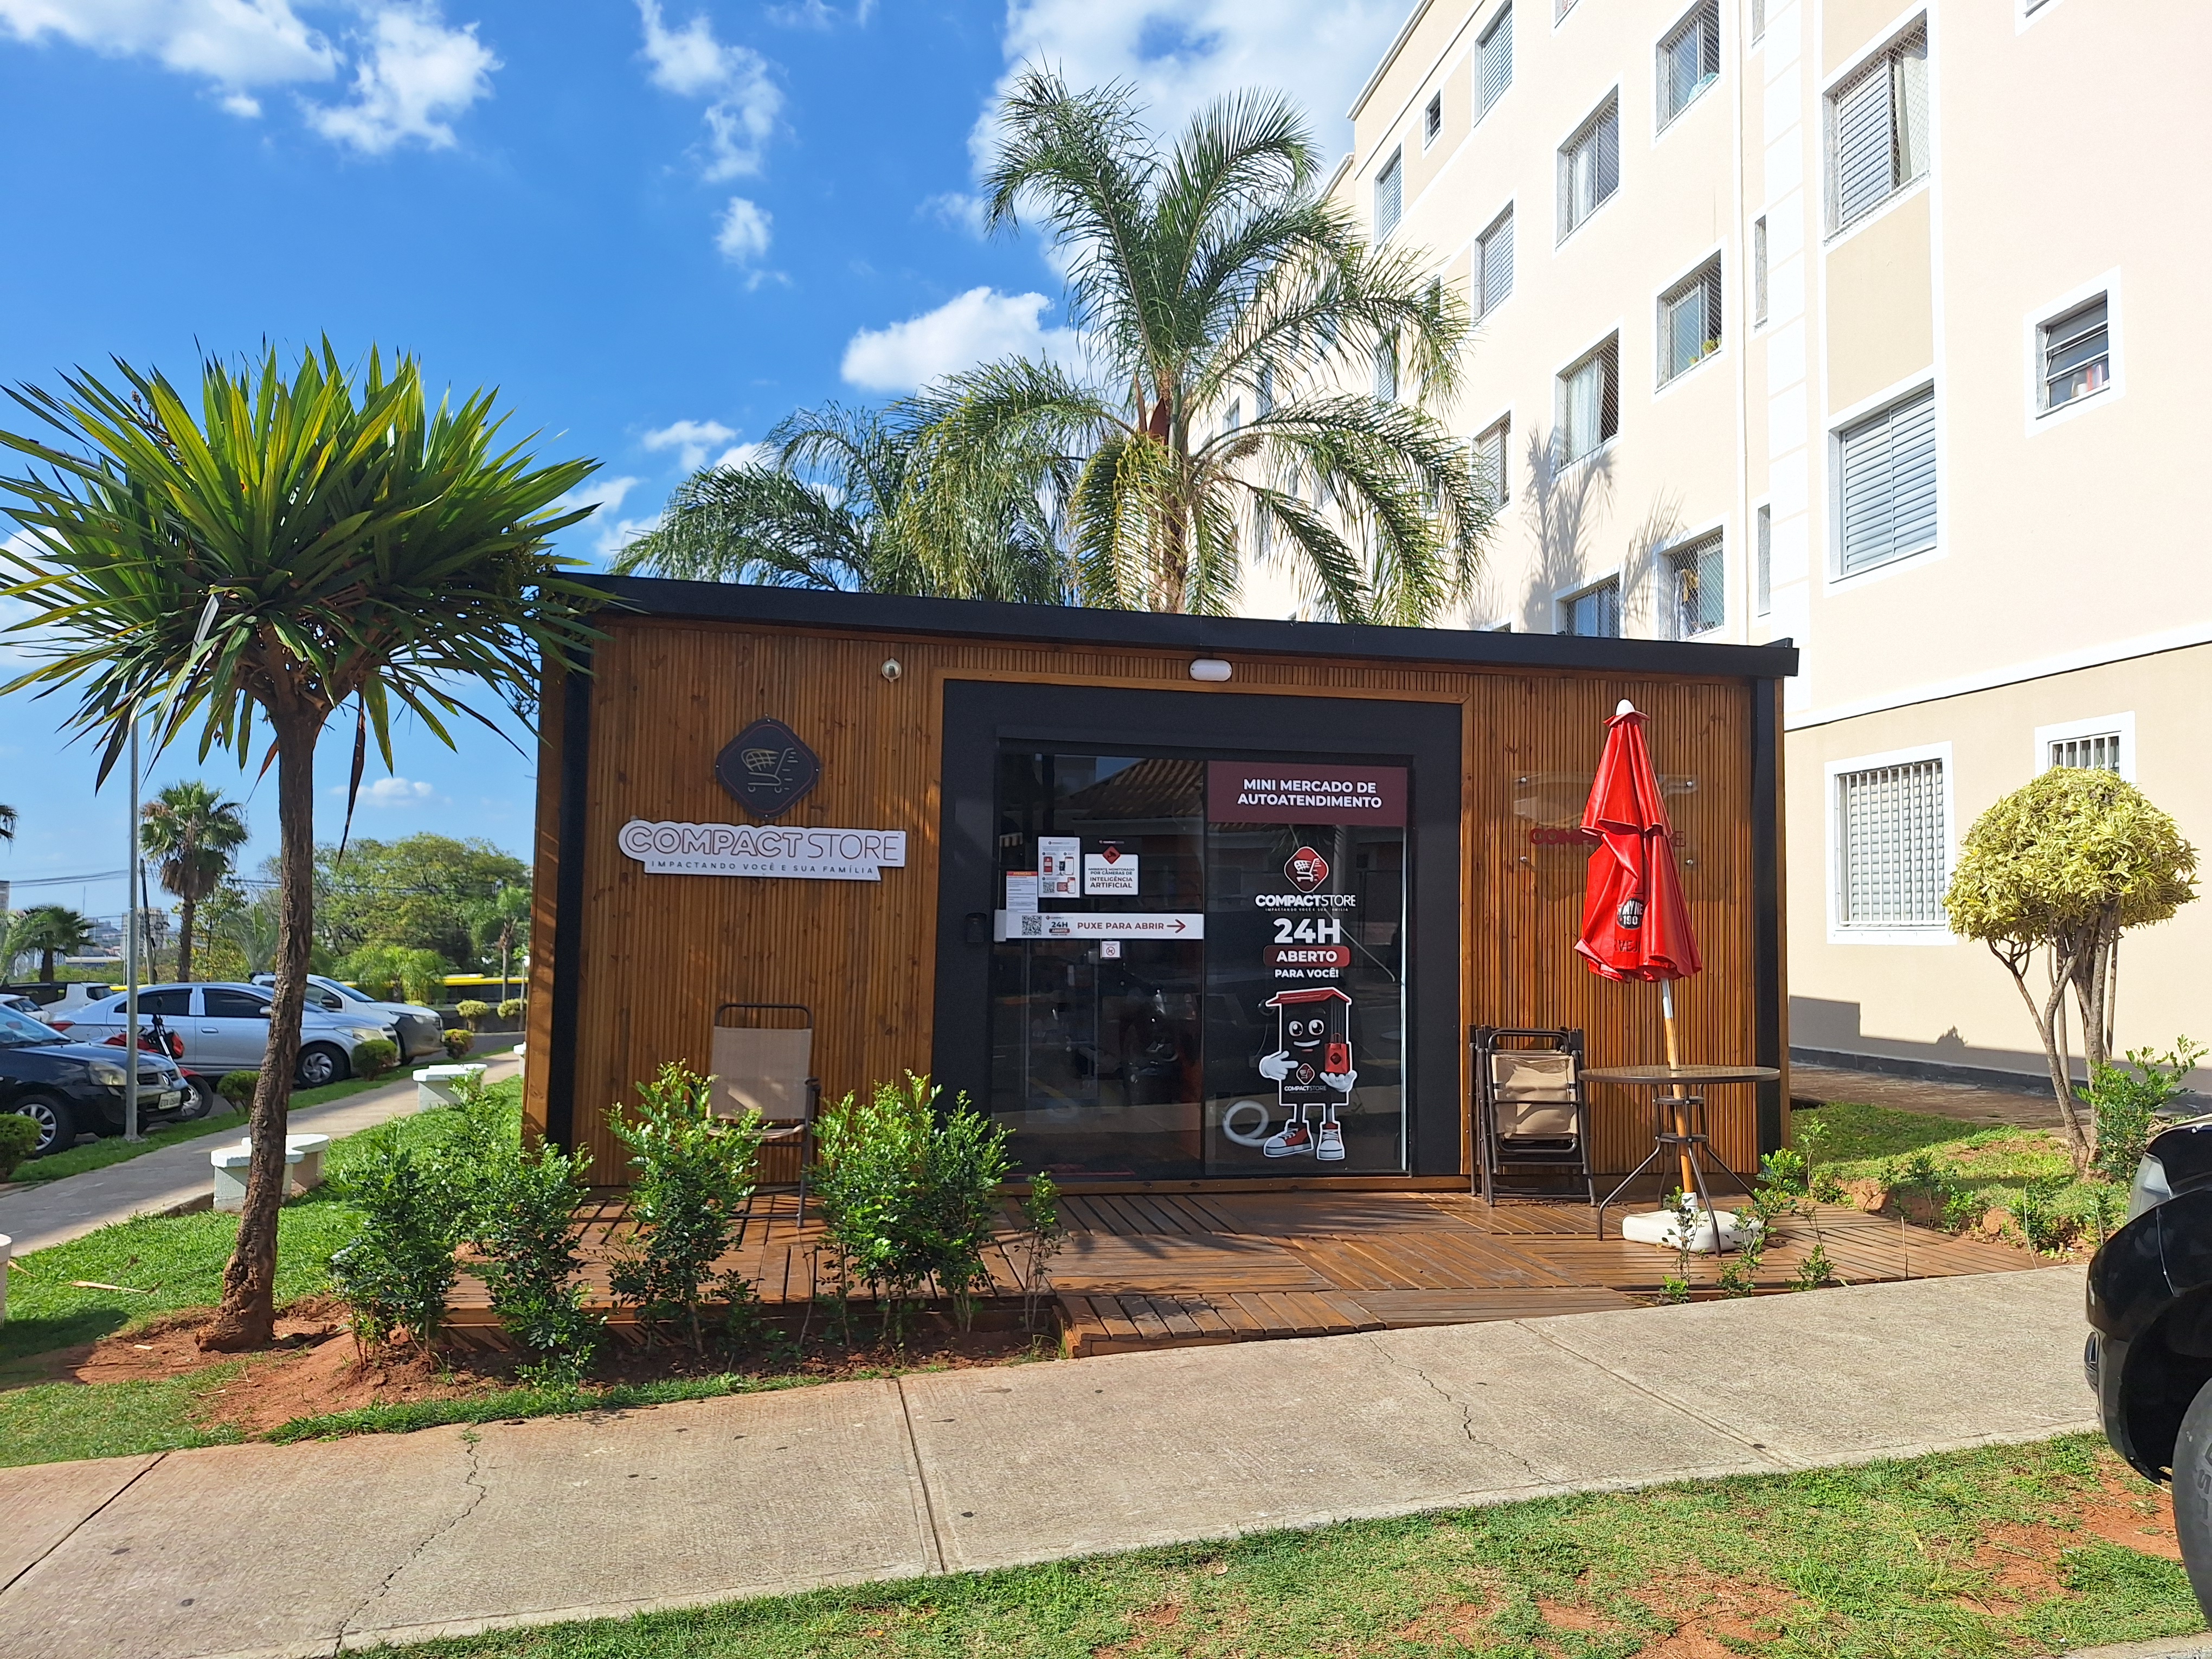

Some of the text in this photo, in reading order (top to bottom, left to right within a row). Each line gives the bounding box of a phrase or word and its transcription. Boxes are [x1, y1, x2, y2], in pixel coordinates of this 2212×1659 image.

[1243, 779, 1377, 793] MINI MERCADO DE
[1237, 793, 1382, 808] AUTOATENDIMENTO
[625, 826, 898, 861] COMPACTSTORE
[652, 860, 736, 870] IMPACTANDO
[743, 862, 775, 871] VOCÊ
[822, 865, 872, 873] FAMÍLIA
[1255, 895, 1356, 907] COMPACTSTORE
[1274, 918, 1340, 943] 24H
[1276, 950, 1338, 962] ABERTO
[1275, 967, 1339, 978] PARA VOCÊ!
